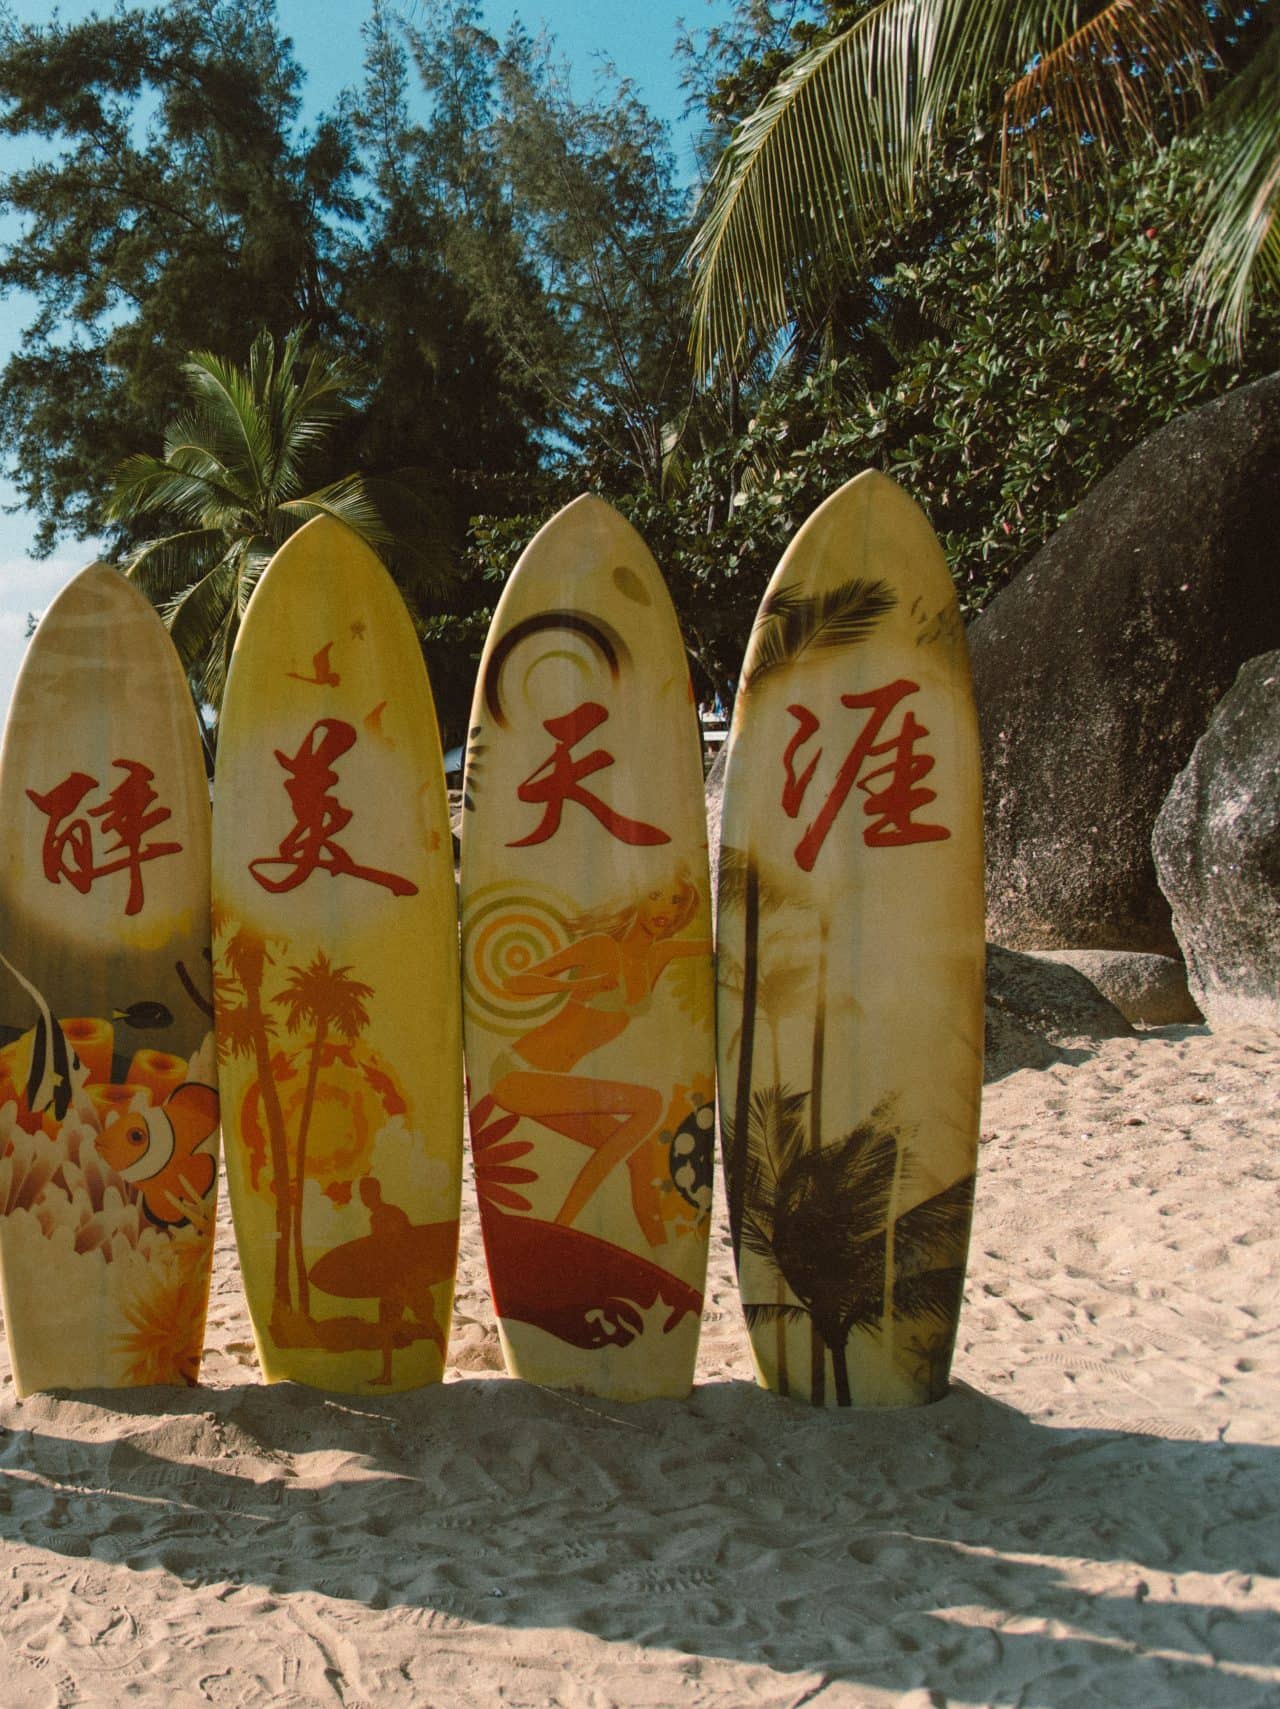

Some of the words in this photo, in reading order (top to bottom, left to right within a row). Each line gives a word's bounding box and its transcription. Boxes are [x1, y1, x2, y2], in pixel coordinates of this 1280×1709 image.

[25, 758, 183, 916] 醉
[248, 718, 419, 897] 美
[505, 702, 672, 848] 天
[781, 679, 951, 873] 涯
